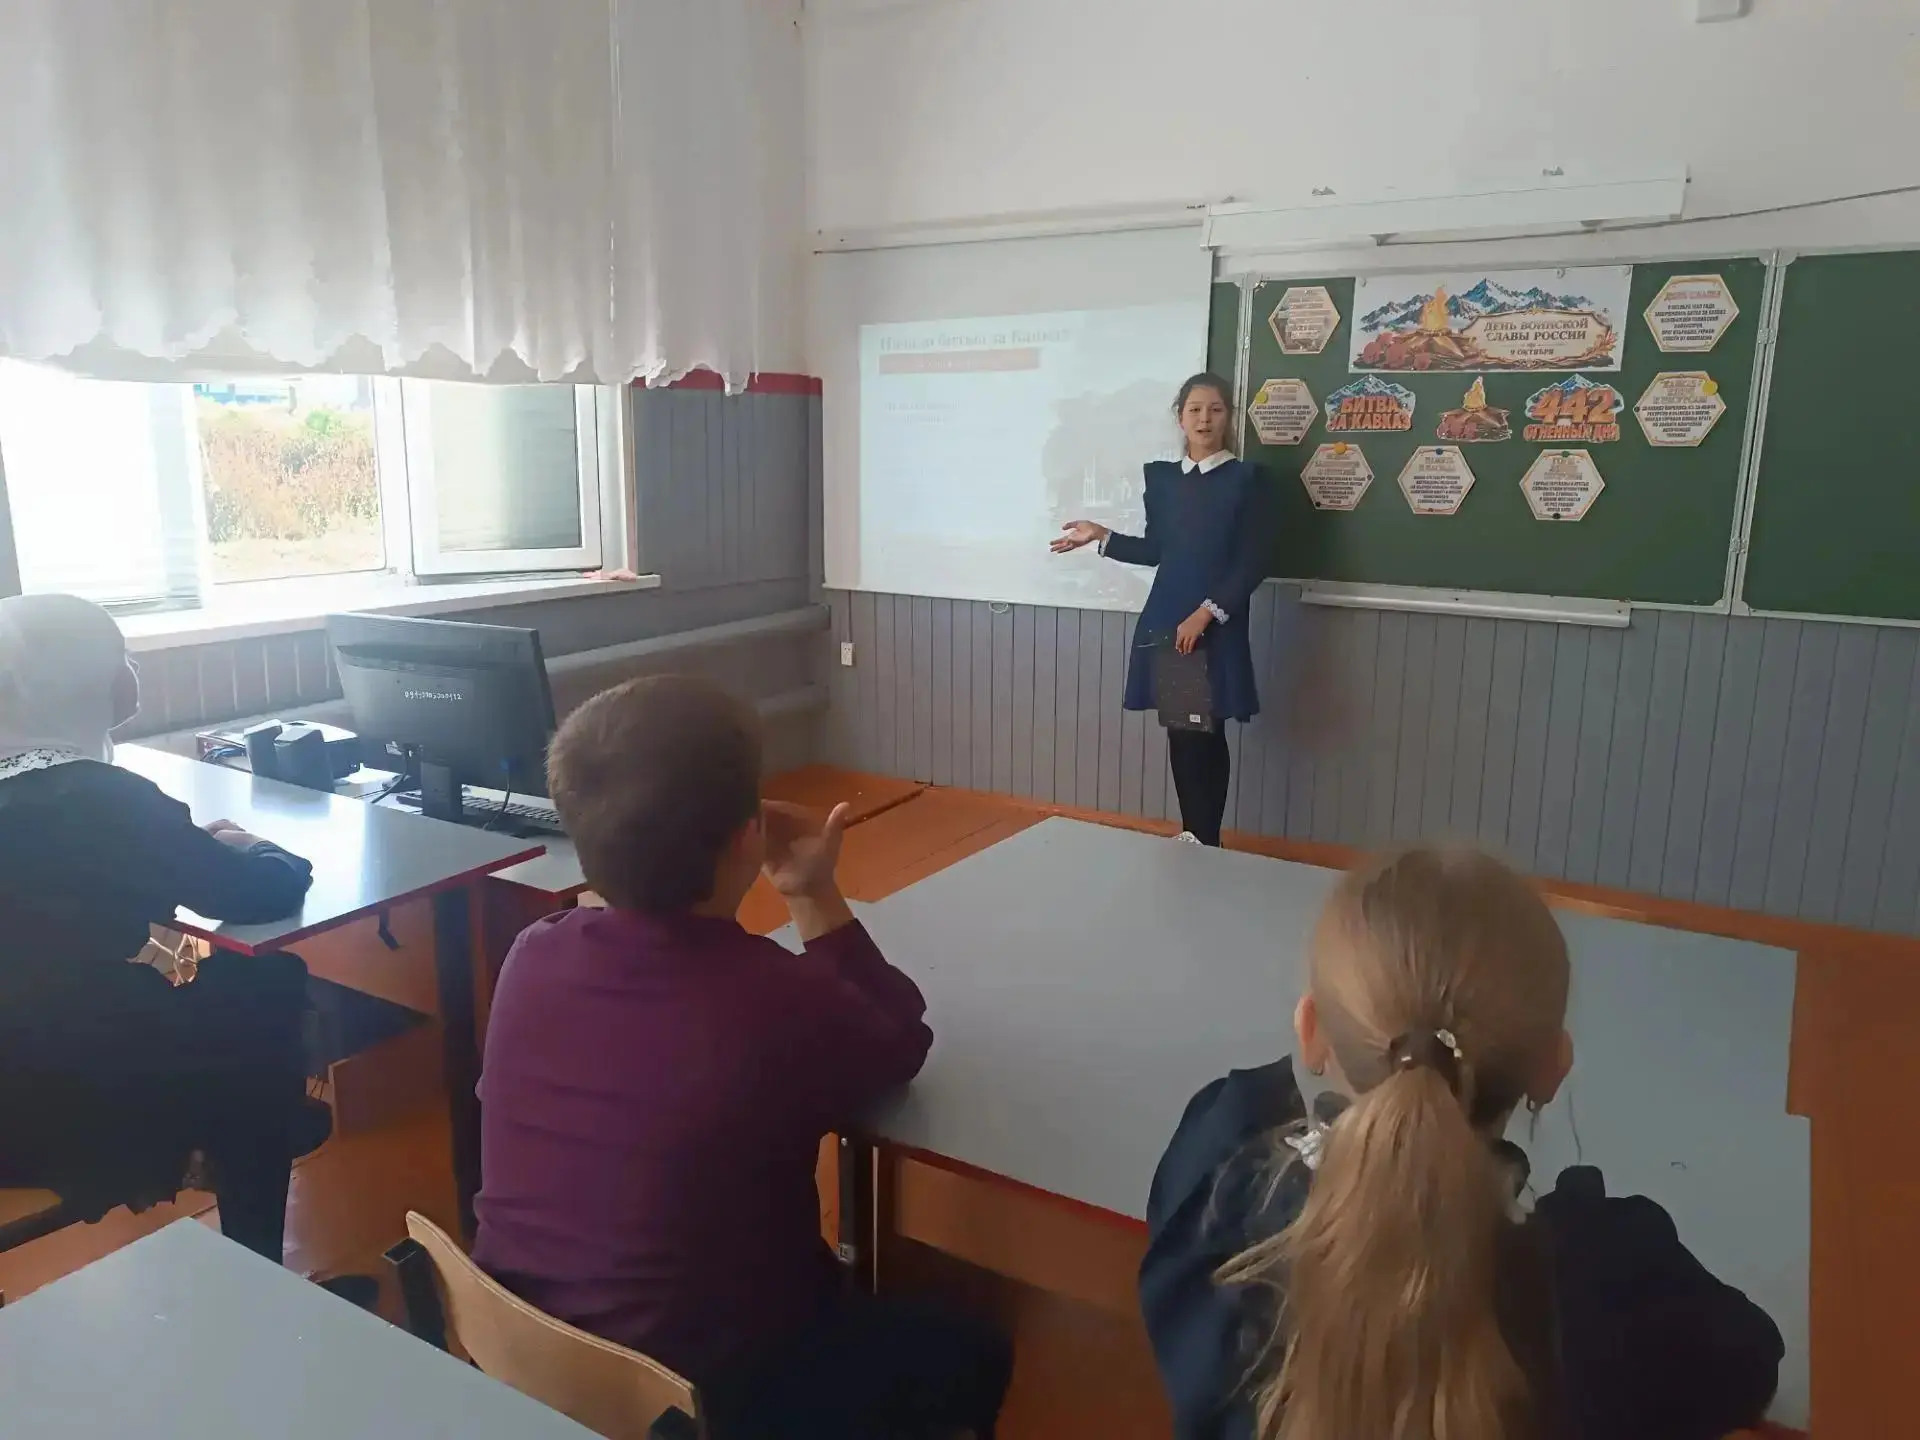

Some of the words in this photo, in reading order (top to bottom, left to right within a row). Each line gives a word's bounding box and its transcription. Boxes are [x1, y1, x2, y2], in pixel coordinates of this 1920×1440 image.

[1484, 321, 1517, 332] ДЕНЬ
[1520, 318, 1589, 330] ВОИНСКОЙ
[1486, 331, 1530, 341] СЛАВЫ
[1534, 330, 1587, 341] РОССИИ
[1517, 348, 1555, 356] ОКТЯБРЯ
[1341, 395, 1400, 413] БИТВА
[1529, 386, 1616, 425] 442
[1349, 413, 1411, 430] КАВКАЗ
